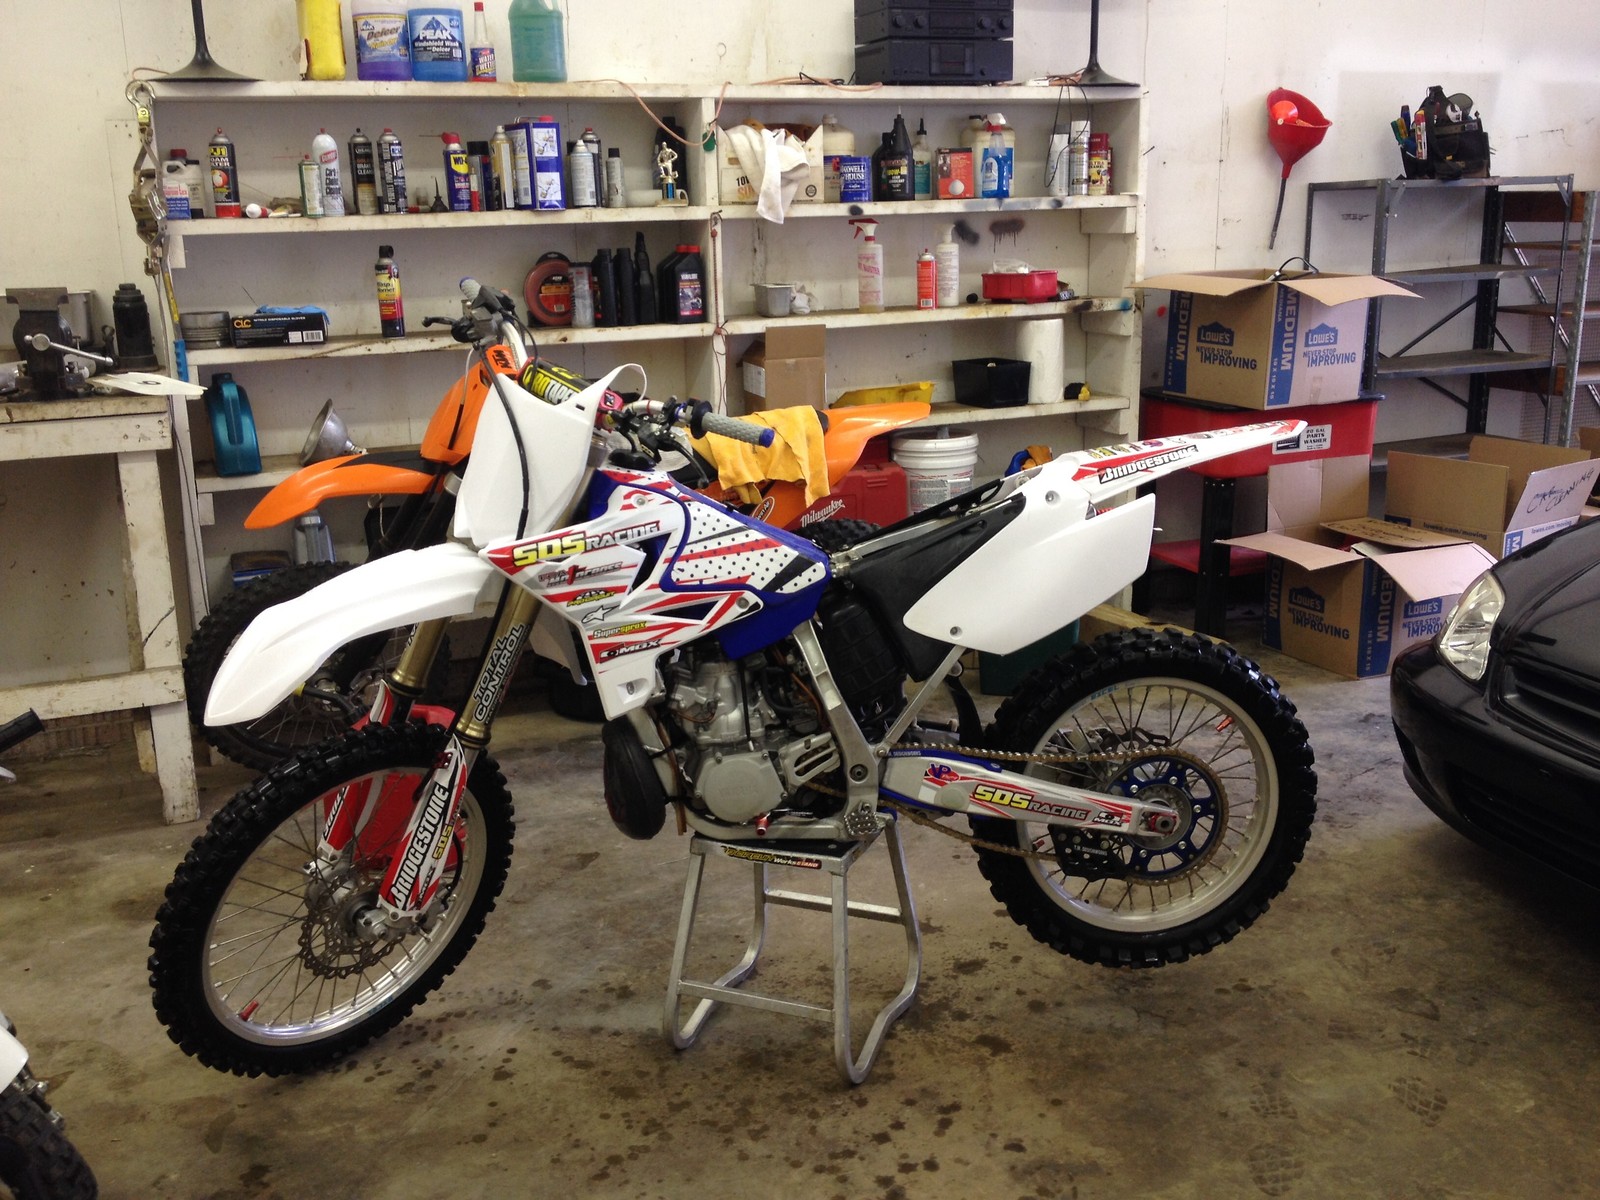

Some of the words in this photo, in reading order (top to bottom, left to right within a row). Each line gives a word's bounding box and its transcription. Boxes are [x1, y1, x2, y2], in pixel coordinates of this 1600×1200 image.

[419, 29, 452, 40] PEAK
[453, 155, 468, 166] WD-
[841, 165, 865, 173] XWELL
[234, 319, 251, 328] CLC
[1281, 289, 1300, 371] MEDIUM
[1201, 329, 1231, 344] LOWE'S
[1308, 333, 1335, 345] LOWE'S
[491, 349, 512, 369] KTM
[1196, 345, 1215, 355] NEVER
[1215, 348, 1233, 356] STOP
[1302, 349, 1320, 358] NEVER
[1320, 347, 1337, 356] STOP
[1200, 353, 1258, 370] IMPROVING
[1307, 352, 1356, 367] IMPROVING
[522, 364, 577, 404] PROTAPE
[1099, 445, 1199, 484] BRIDGESTONE
[800, 498, 843, 527] Milwaukee
[586, 521, 661, 550] RACING
[1423, 521, 1488, 540] lowes.com/moving
[1268, 559, 1282, 620] EDIUM
[1291, 592, 1323, 610] LOWE'S
[1407, 601, 1439, 617] LOWE'S
[1287, 608, 1307, 619] NEVER
[1308, 612, 1324, 622] STOP
[593, 621, 647, 639] Supersprox
[1292, 613, 1350, 640] IMPROVING
[1402, 619, 1423, 630] NEVER
[1407, 621, 1444, 638] IMPRO
[473, 635, 508, 702] TOTAL
[474, 623, 525, 722] CONTROL
[930, 763, 951, 780] VP
[1028, 801, 1090, 820] RACING
[390, 783, 449, 909] BRIDGESTONE
